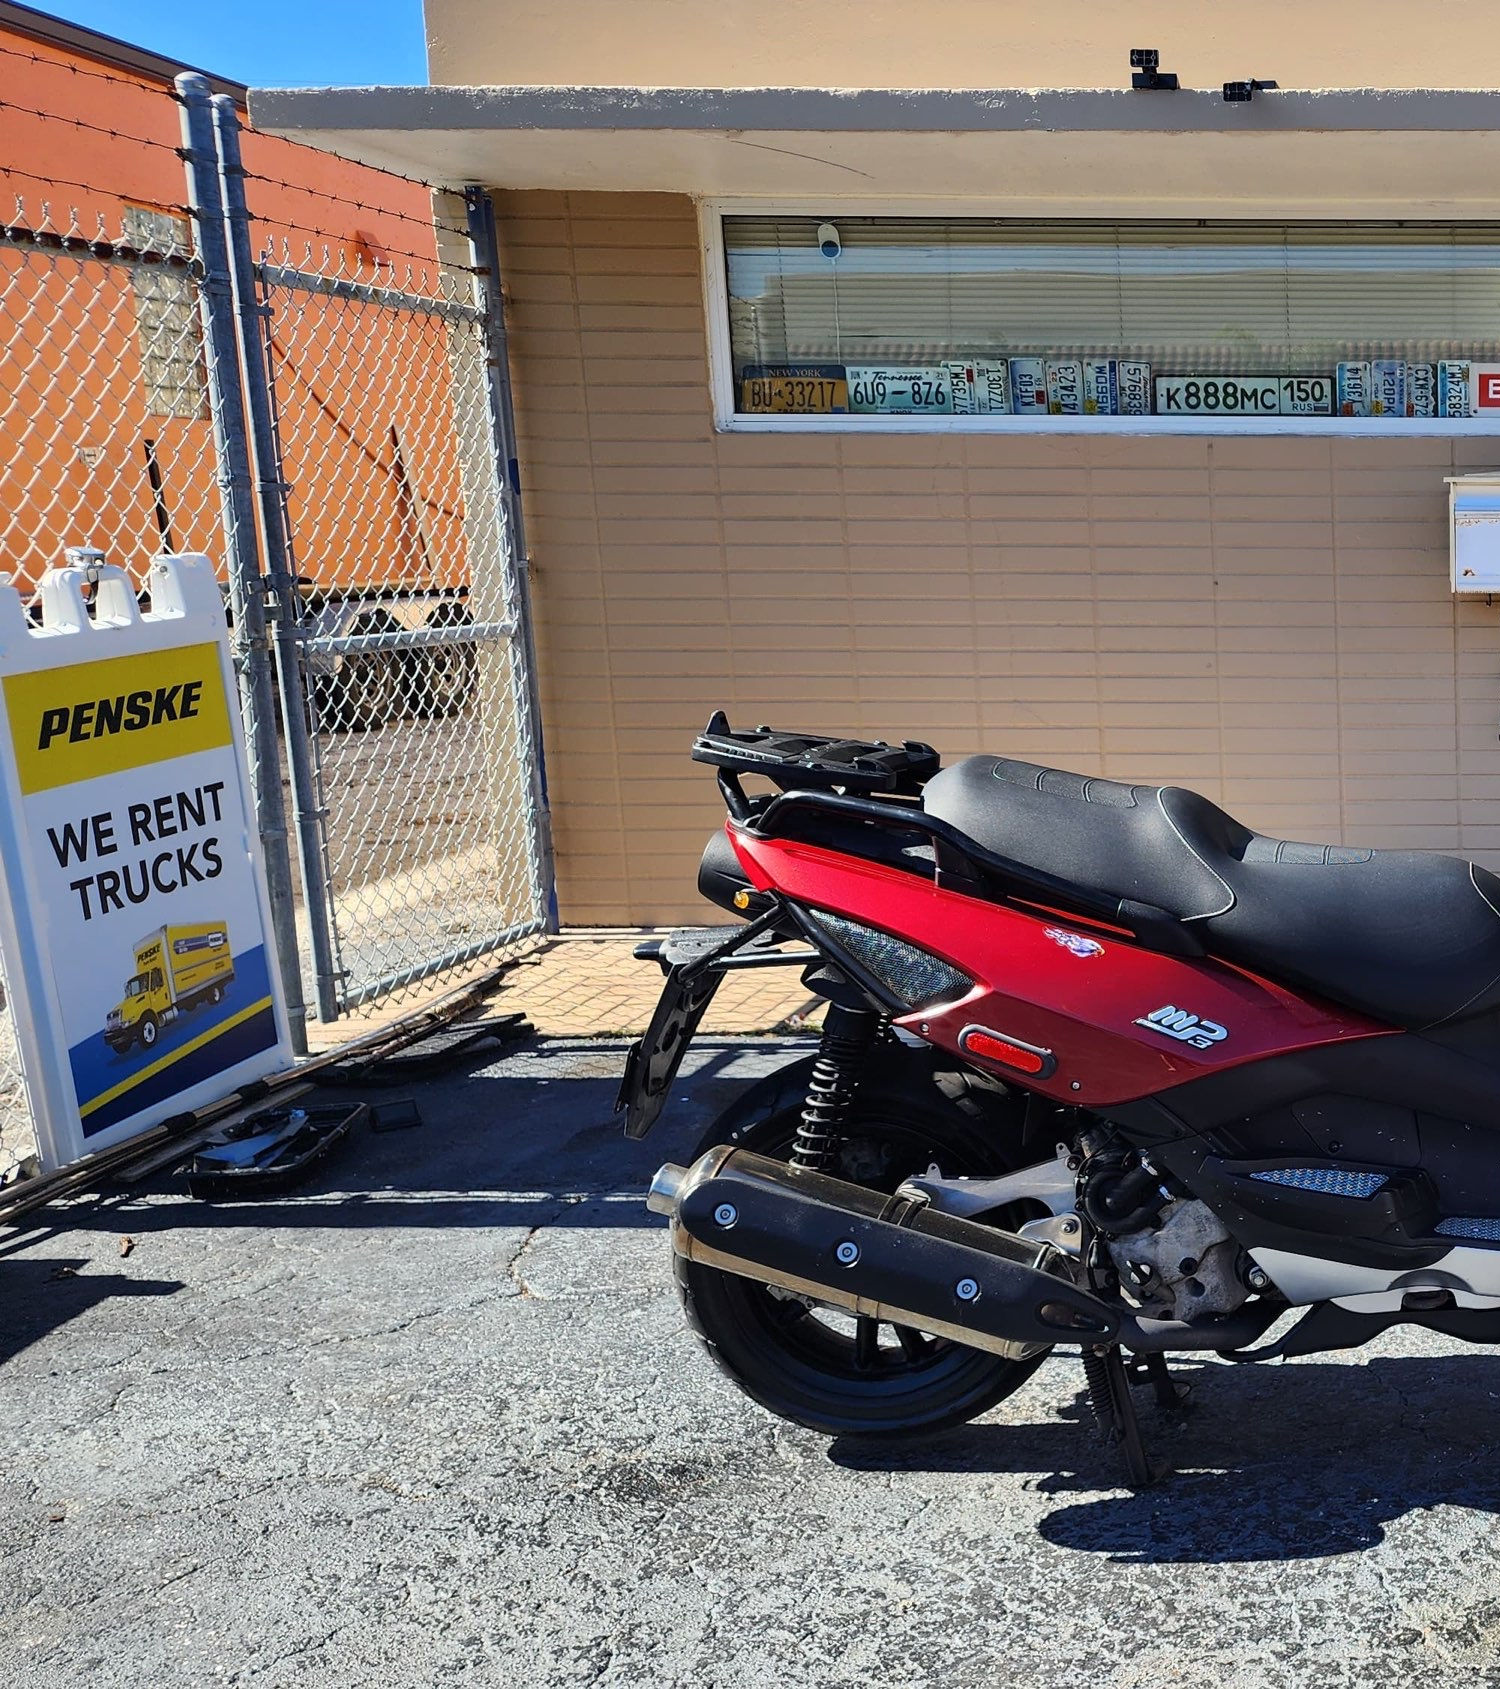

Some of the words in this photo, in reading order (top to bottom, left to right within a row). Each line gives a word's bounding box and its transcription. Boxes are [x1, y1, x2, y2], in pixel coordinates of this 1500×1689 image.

[769, 369, 791, 377] NEW
[796, 369, 821, 377] YORK
[872, 371, 924, 383] Tennessee
[751, 381, 773, 407] BU
[784, 381, 836, 408] 33217
[1283, 380, 1325, 402] 150
[1291, 402, 1314, 412] RUS
[38, 680, 203, 751] PENSKE
[46, 811, 118, 869] WE
[127, 781, 225, 847] RENT
[69, 837, 223, 921] TRUCKS
